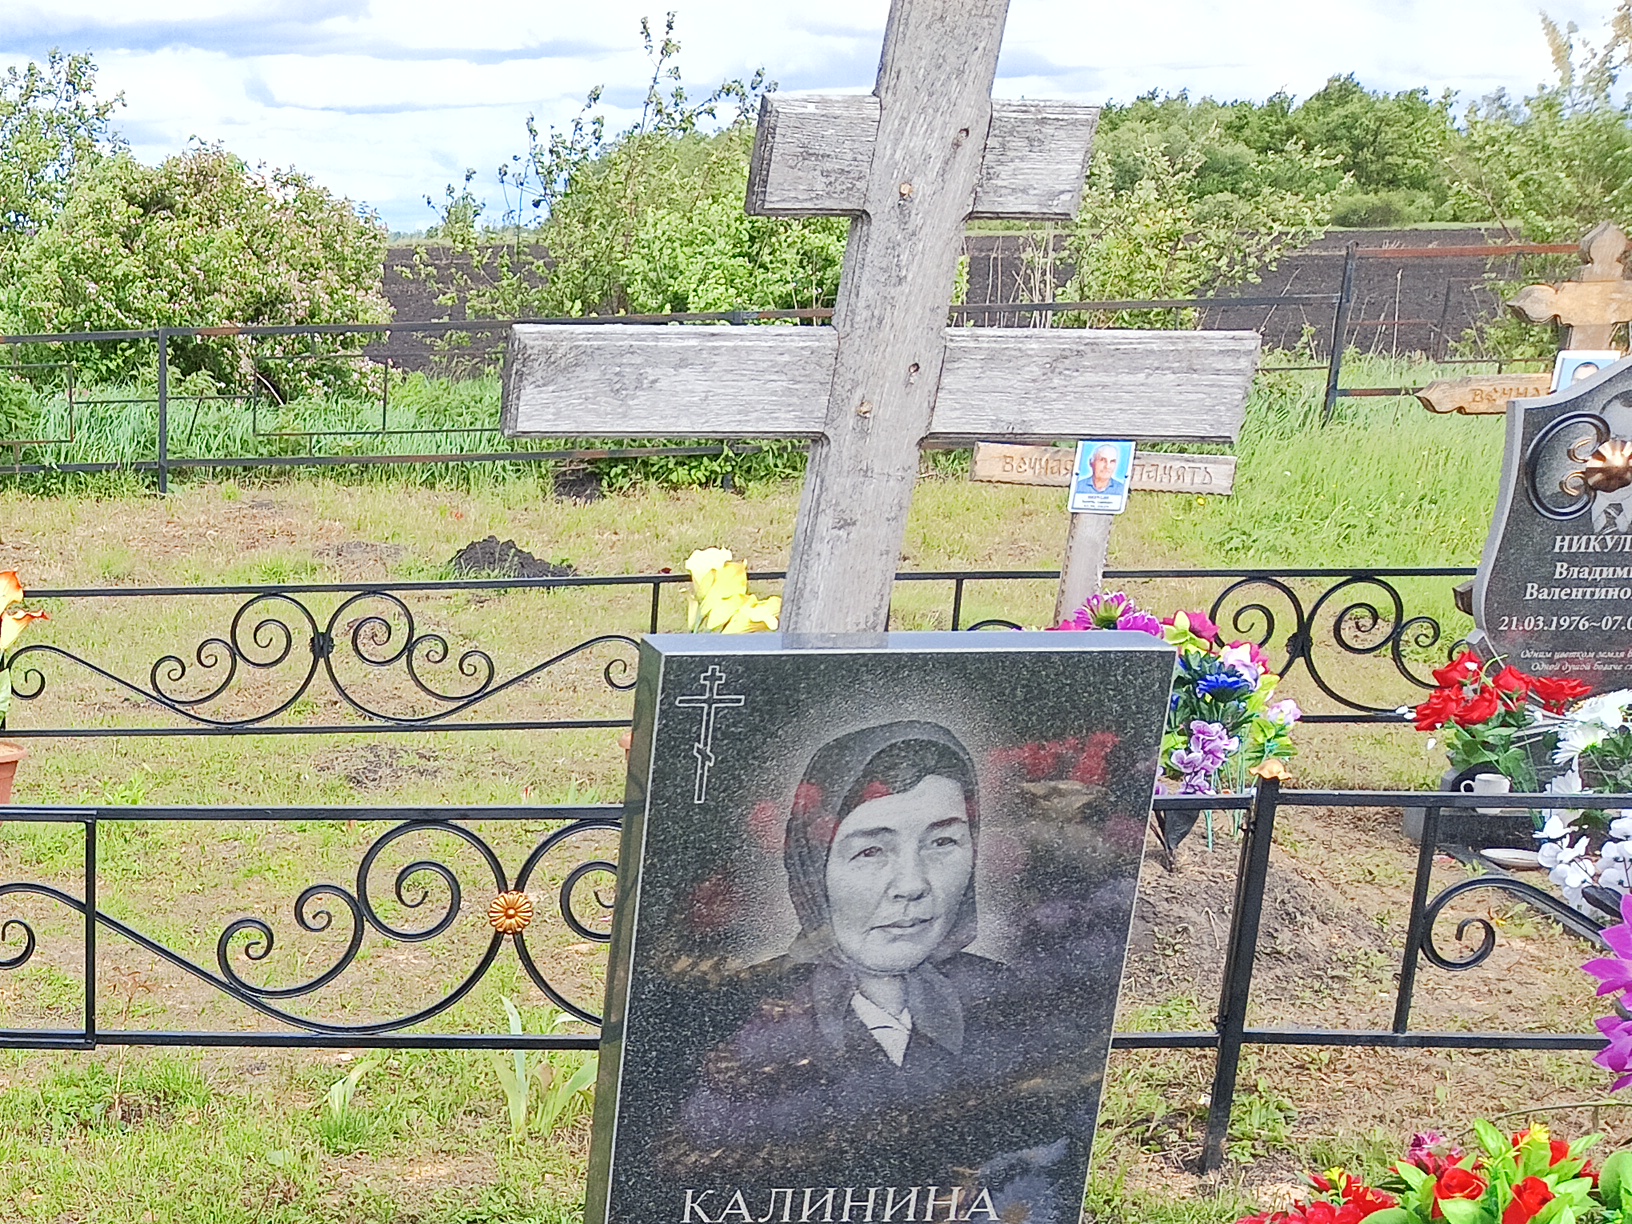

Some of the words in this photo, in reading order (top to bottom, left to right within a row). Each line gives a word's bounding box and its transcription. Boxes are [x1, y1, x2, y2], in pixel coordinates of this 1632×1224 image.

[1553, 562, 1632, 582] Владим
[1523, 583, 1632, 600] Валентино
[680, 1186, 1002, 1224] КАЛИНИНА
